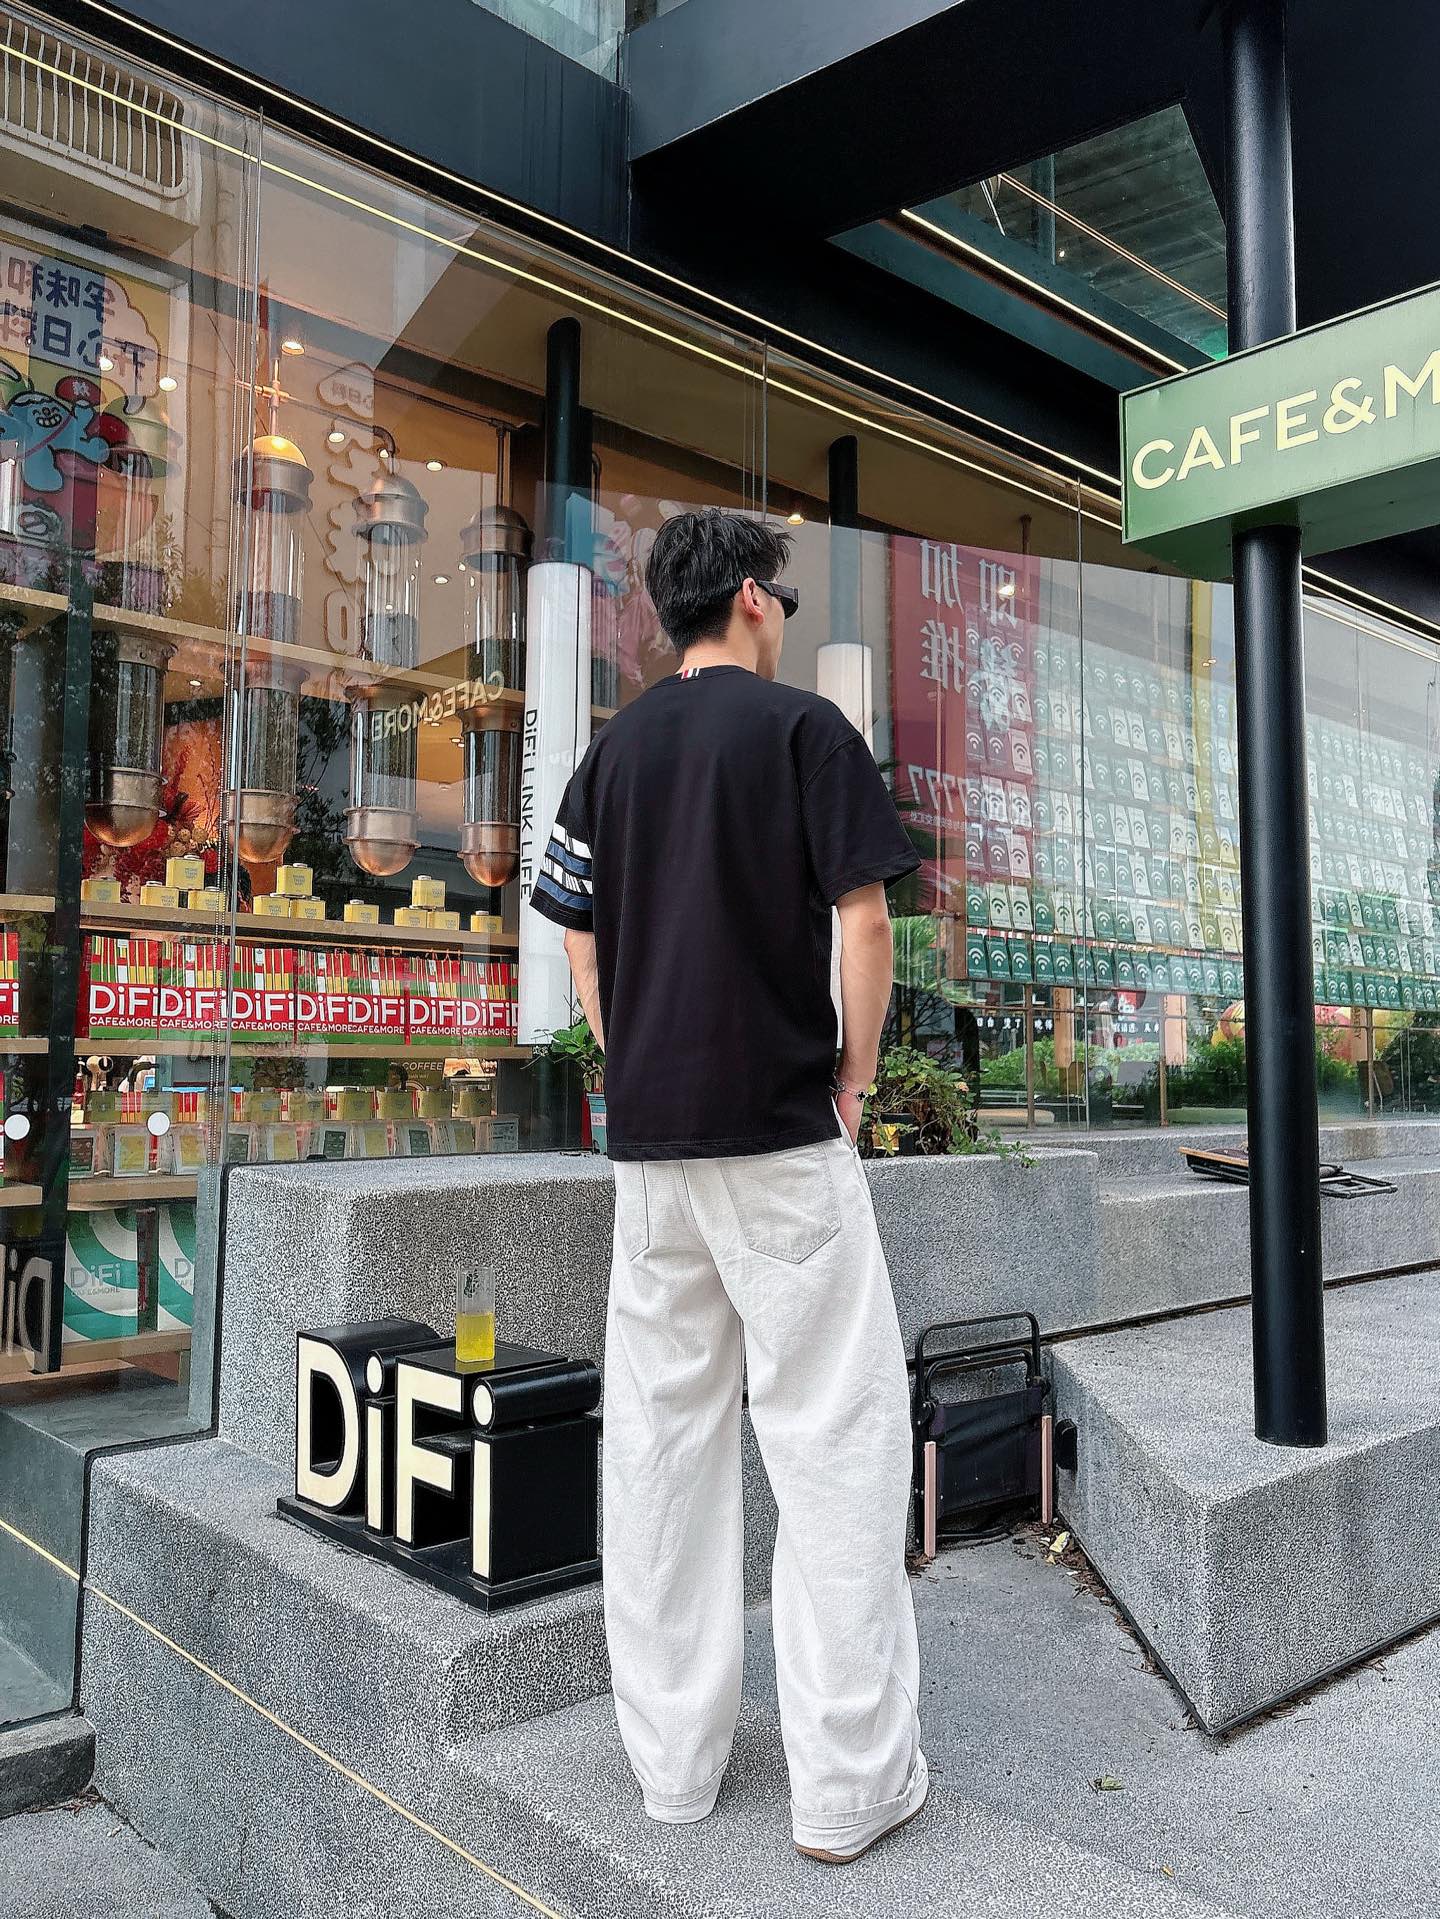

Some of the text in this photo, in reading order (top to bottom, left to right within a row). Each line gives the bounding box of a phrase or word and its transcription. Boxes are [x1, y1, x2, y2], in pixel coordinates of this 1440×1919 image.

[1131, 349, 1440, 490] CAFE&M
[520, 708, 538, 900] DiFi LINK LIFE
[90, 985, 158, 1016] DiFi
[160, 987, 228, 1018] DiFi
[231, 991, 295, 1020] DiFi
[297, 993, 353, 1022] DiFi
[352, 996, 405, 1025] DiFi
[410, 998, 461, 1025] DiFi
[461, 1000, 511, 1027] DiFi
[89, 1016, 157, 1027] CAFE&MORE
[159, 1018, 228, 1030] CAFE&MORE
[231, 1021, 294, 1031] CAFE&MORE
[410, 1026, 461, 1035] CAFE&MORE
[462, 1027, 510, 1036] CAFE&MORE
[402, 1061, 443, 1071] COFFEE
[70, 1262, 121, 1288] DiFi
[297, 1335, 493, 1579] DiFi
